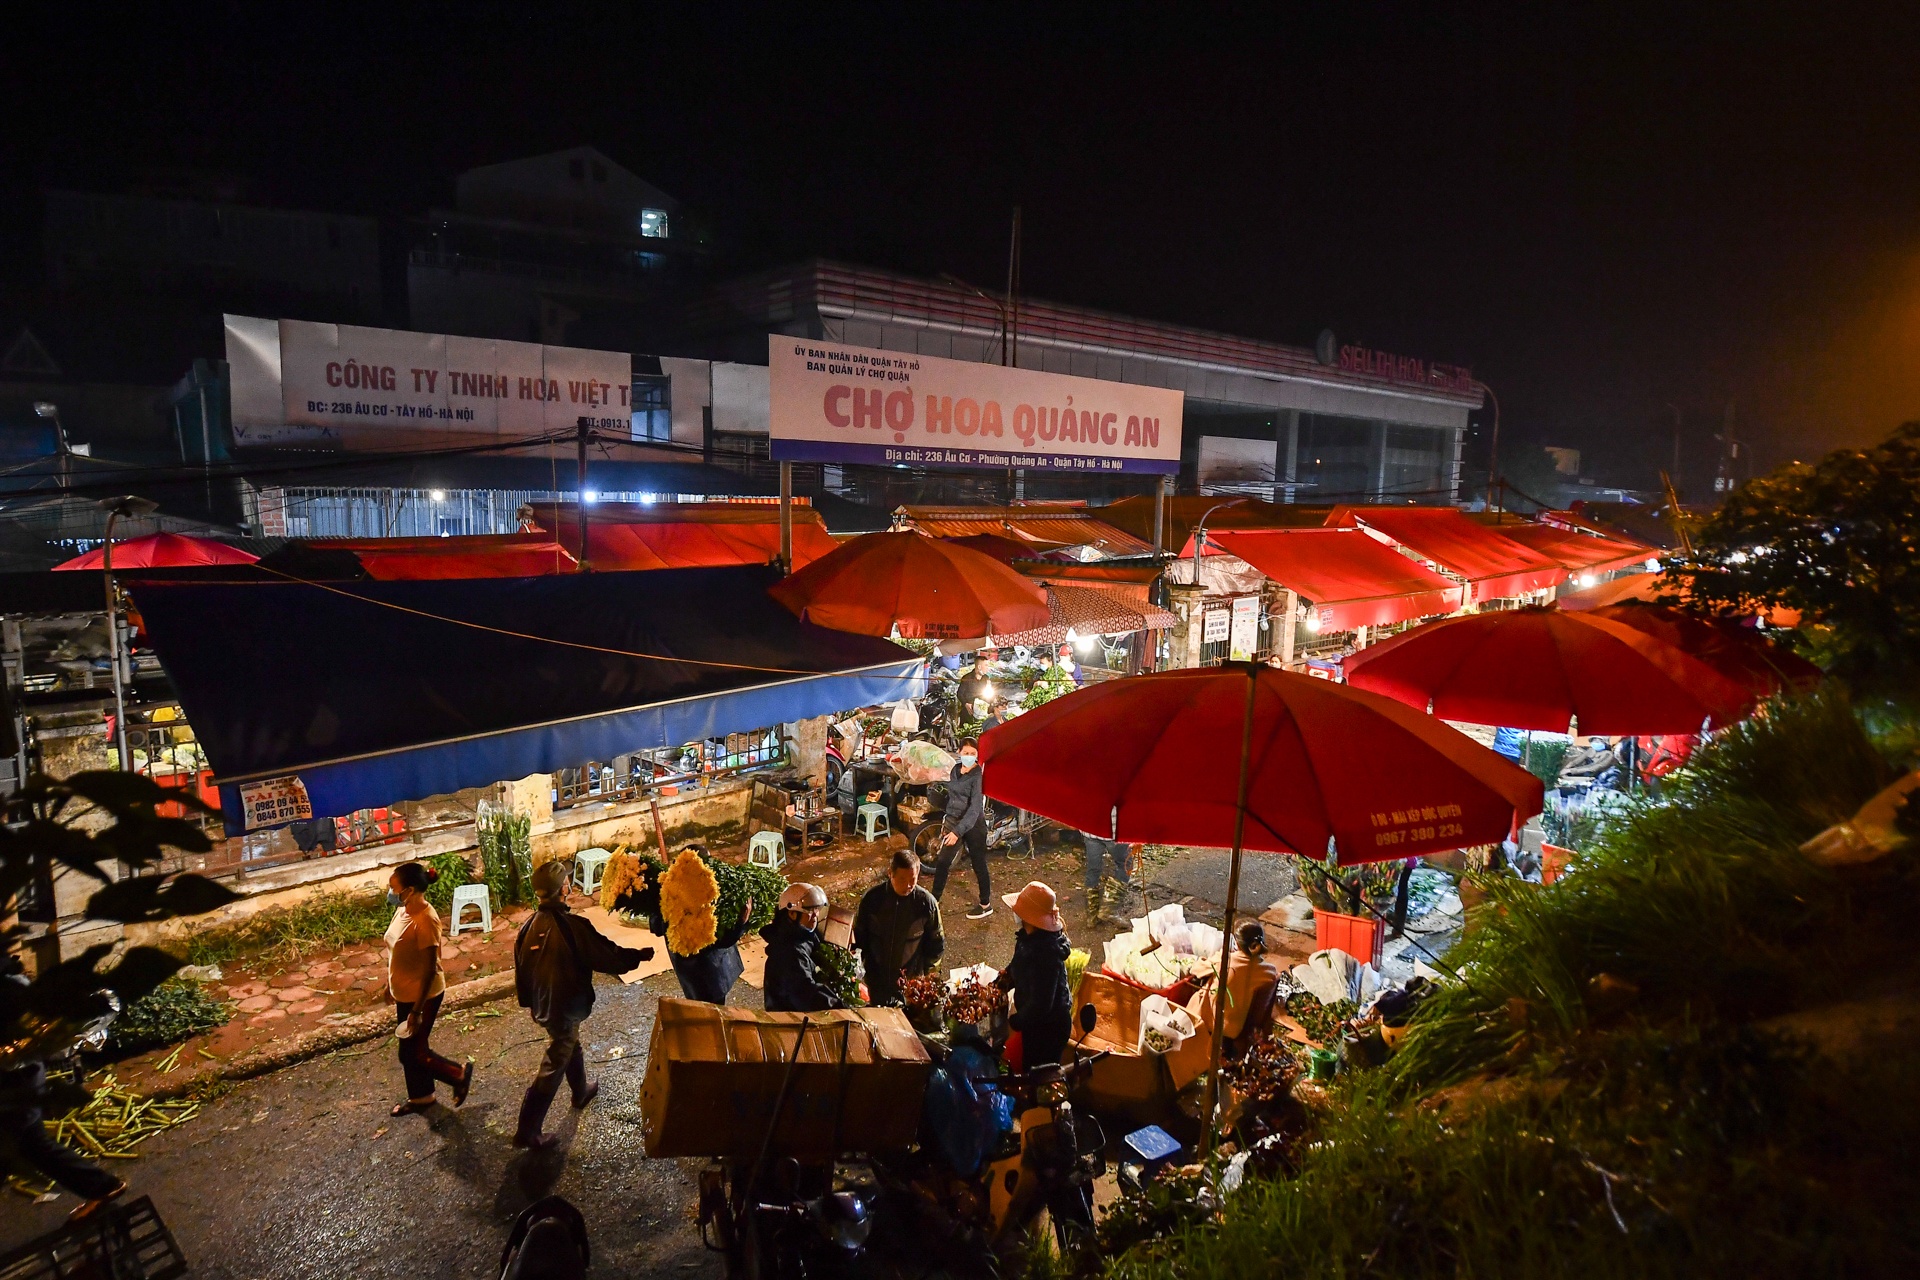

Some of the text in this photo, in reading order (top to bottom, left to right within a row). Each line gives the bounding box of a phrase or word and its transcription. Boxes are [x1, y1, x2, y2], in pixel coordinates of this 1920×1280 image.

[808, 348, 826, 359] BAN
[828, 350, 850, 362] NHÂN
[852, 353, 869, 364] DÂN
[871, 356, 891, 369] QUẬN
[893, 359, 907, 369] TÂY
[325, 358, 632, 408] CÔNG TY TNHH HOA VIỆT T
[806, 361, 910, 383] BAN QUẢN LÝ CHỢ QUẬN
[331, 402, 353, 414] 236
[354, 401, 370, 415] ÂU
[372, 404, 388, 416] CƠ
[396, 403, 416, 418] TÂY
[456, 407, 475, 422] NỘI
[822, 383, 1160, 448] CHỢ HOA QUẢNG AN
[885, 448, 902, 462] Địa
[925, 451, 943, 463] 236
[944, 450, 957, 463] Âu
[958, 452, 971, 463] Cơ
[978, 453, 1010, 466] Phường
[1011, 454, 1035, 467] Quảng
[1037, 456, 1047, 466] An
[1053, 456, 1071, 468] Quận
[1101, 458, 1111, 469] Hà
[1111, 459, 1123, 471] Nội
[255, 799, 276, 812] 0982
[276, 797, 287, 808] 09
[288, 796, 299, 805] 44
[256, 810, 277, 822] 0846
[279, 807, 294, 818] 870
[296, 804, 311, 815] 555
[1375, 829, 1407, 846] 0967
[1438, 823, 1463, 838] 234
